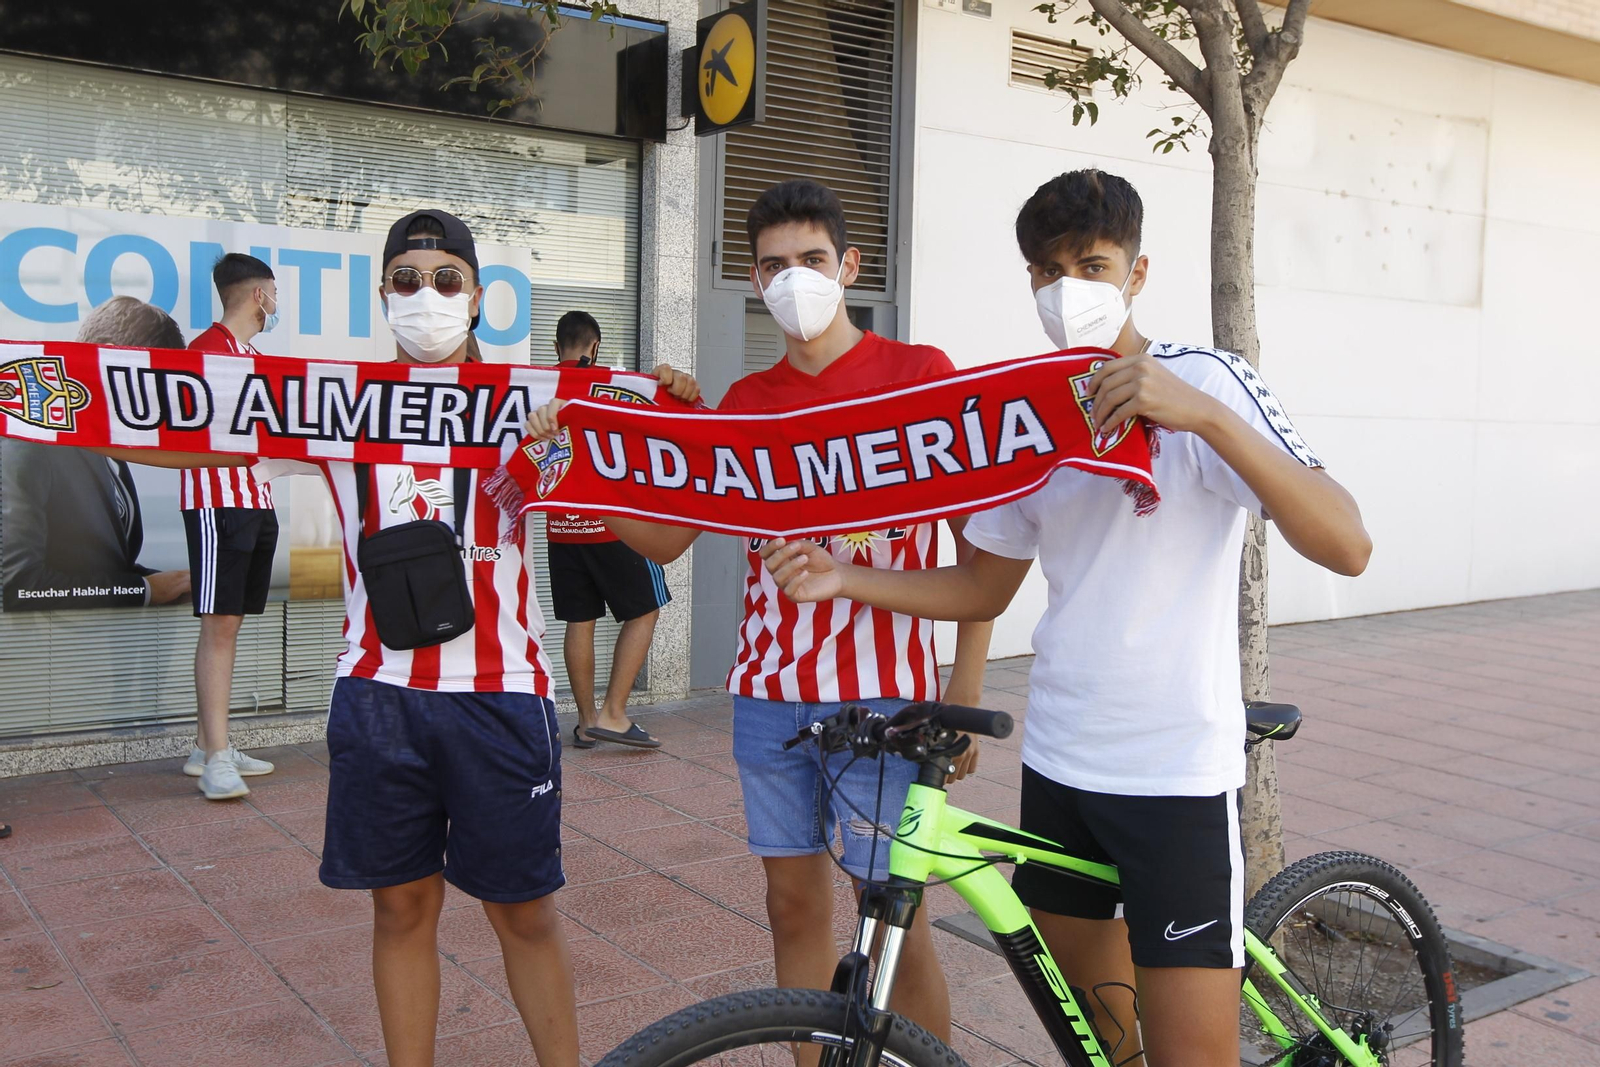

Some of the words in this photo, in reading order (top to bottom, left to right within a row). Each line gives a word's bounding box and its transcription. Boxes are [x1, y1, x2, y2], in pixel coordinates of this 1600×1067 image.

[0, 226, 531, 348] CONTIO
[20, 364, 42, 419] ALMERIA
[107, 365, 214, 431] UD
[229, 373, 533, 449] ALMERIA
[460, 543, 502, 561] ntres
[18, 587, 70, 599] Escuchar
[72, 586, 111, 597] Hablar
[113, 585, 145, 595] Hacer
[531, 779, 554, 798] FILA
[1390, 899, 1423, 939] DISC
[1446, 1003, 1457, 1029] Tyres
